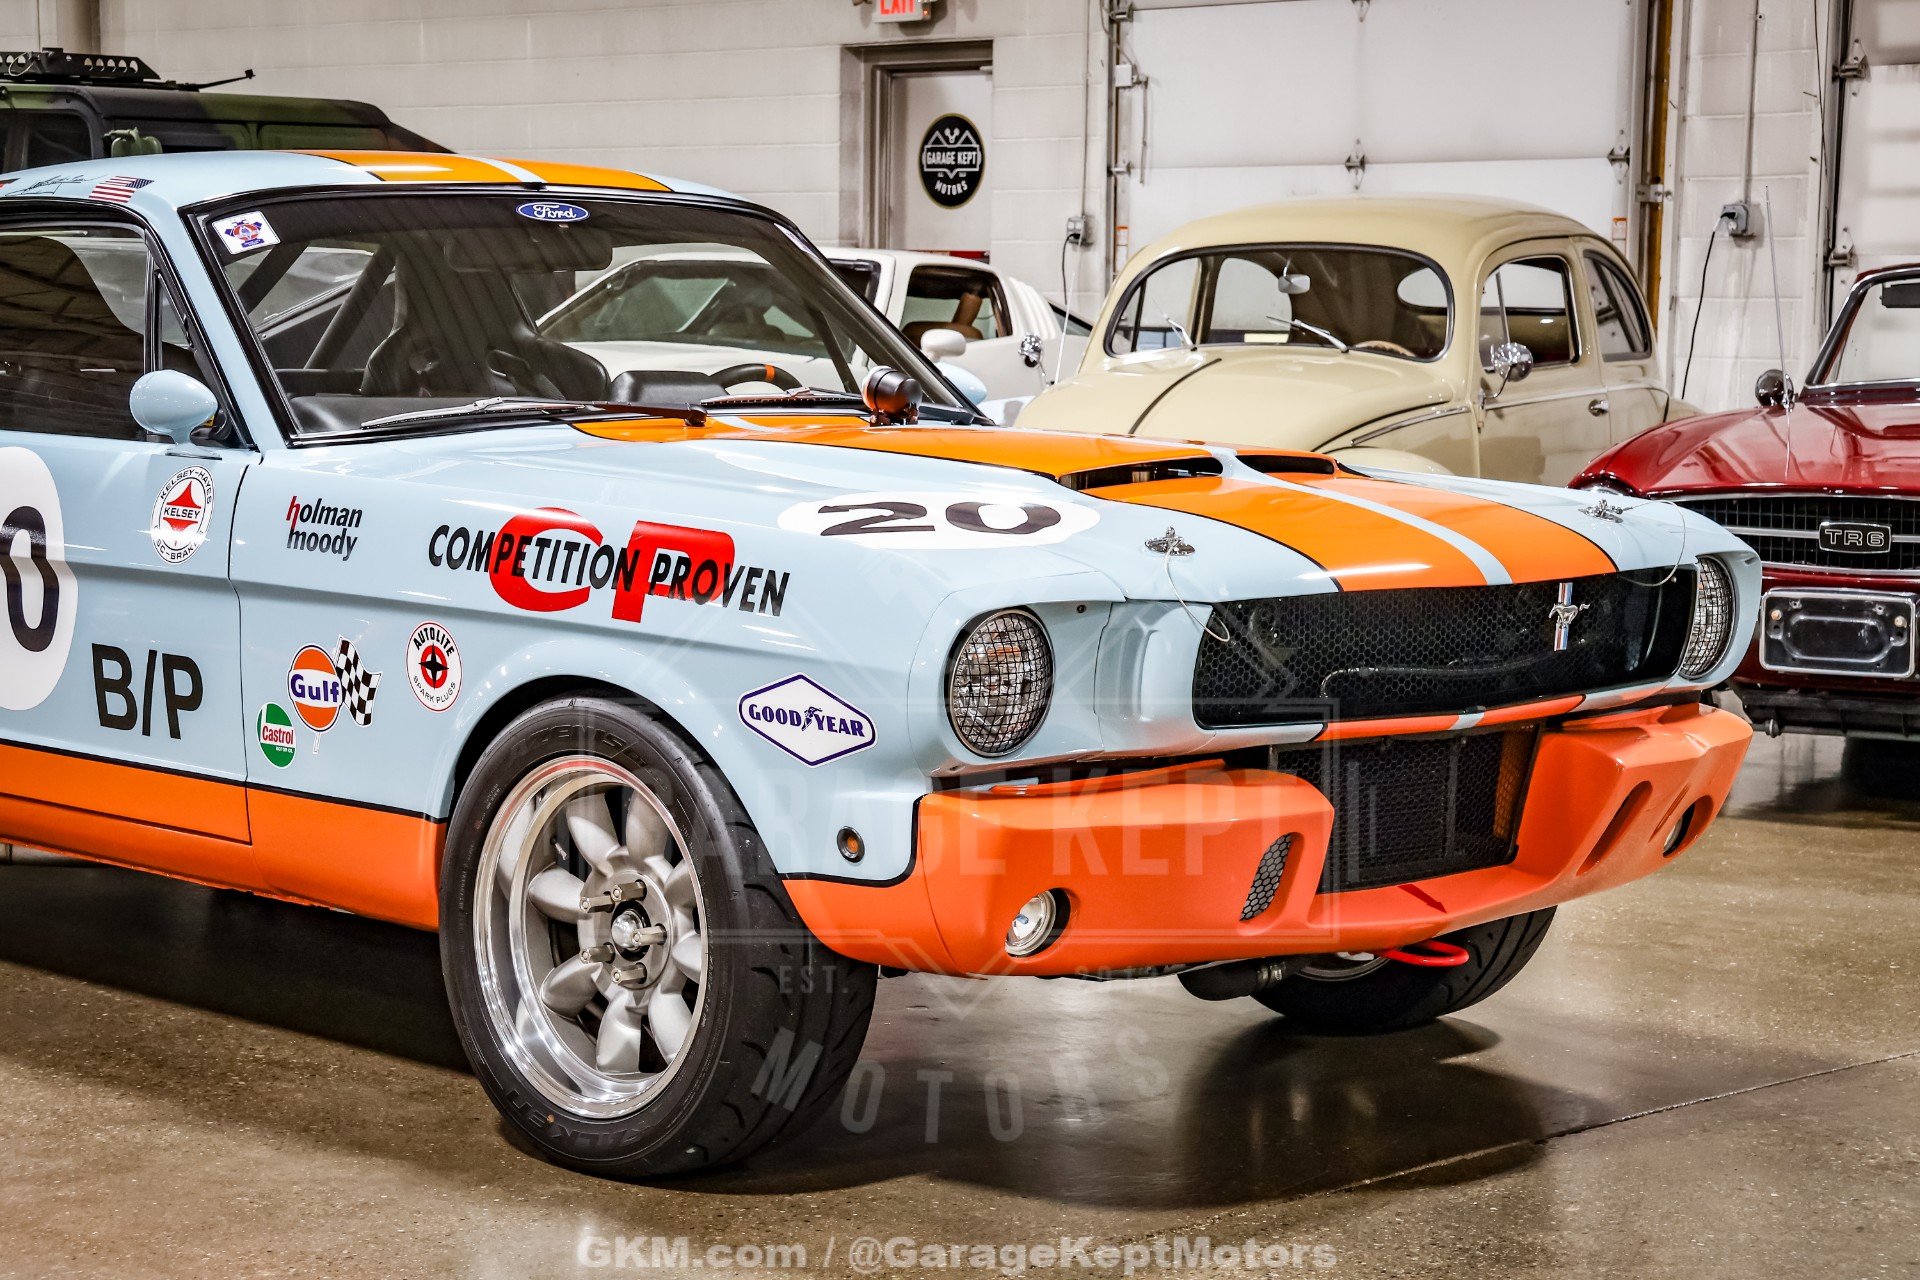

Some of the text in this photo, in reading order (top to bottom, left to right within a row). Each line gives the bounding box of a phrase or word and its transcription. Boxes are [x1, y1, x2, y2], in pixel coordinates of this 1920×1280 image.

[926, 151, 978, 165] GARAGE KEPT
[934, 180, 968, 196] MOTORS
[532, 204, 577, 218] Ford
[163, 506, 201, 519] KELSEY
[286, 495, 363, 529] holman
[818, 501, 1061, 537] 20
[286, 527, 359, 562] moody
[1824, 528, 1885, 547] TR6
[428, 524, 791, 617] COMPETITION PROVEN
[413, 626, 455, 657] AUTOLITE
[91, 642, 204, 740] B/P
[290, 673, 340, 703] Gulf
[413, 675, 456, 704] SPARK PLUGS
[262, 725, 294, 745] Castrol
